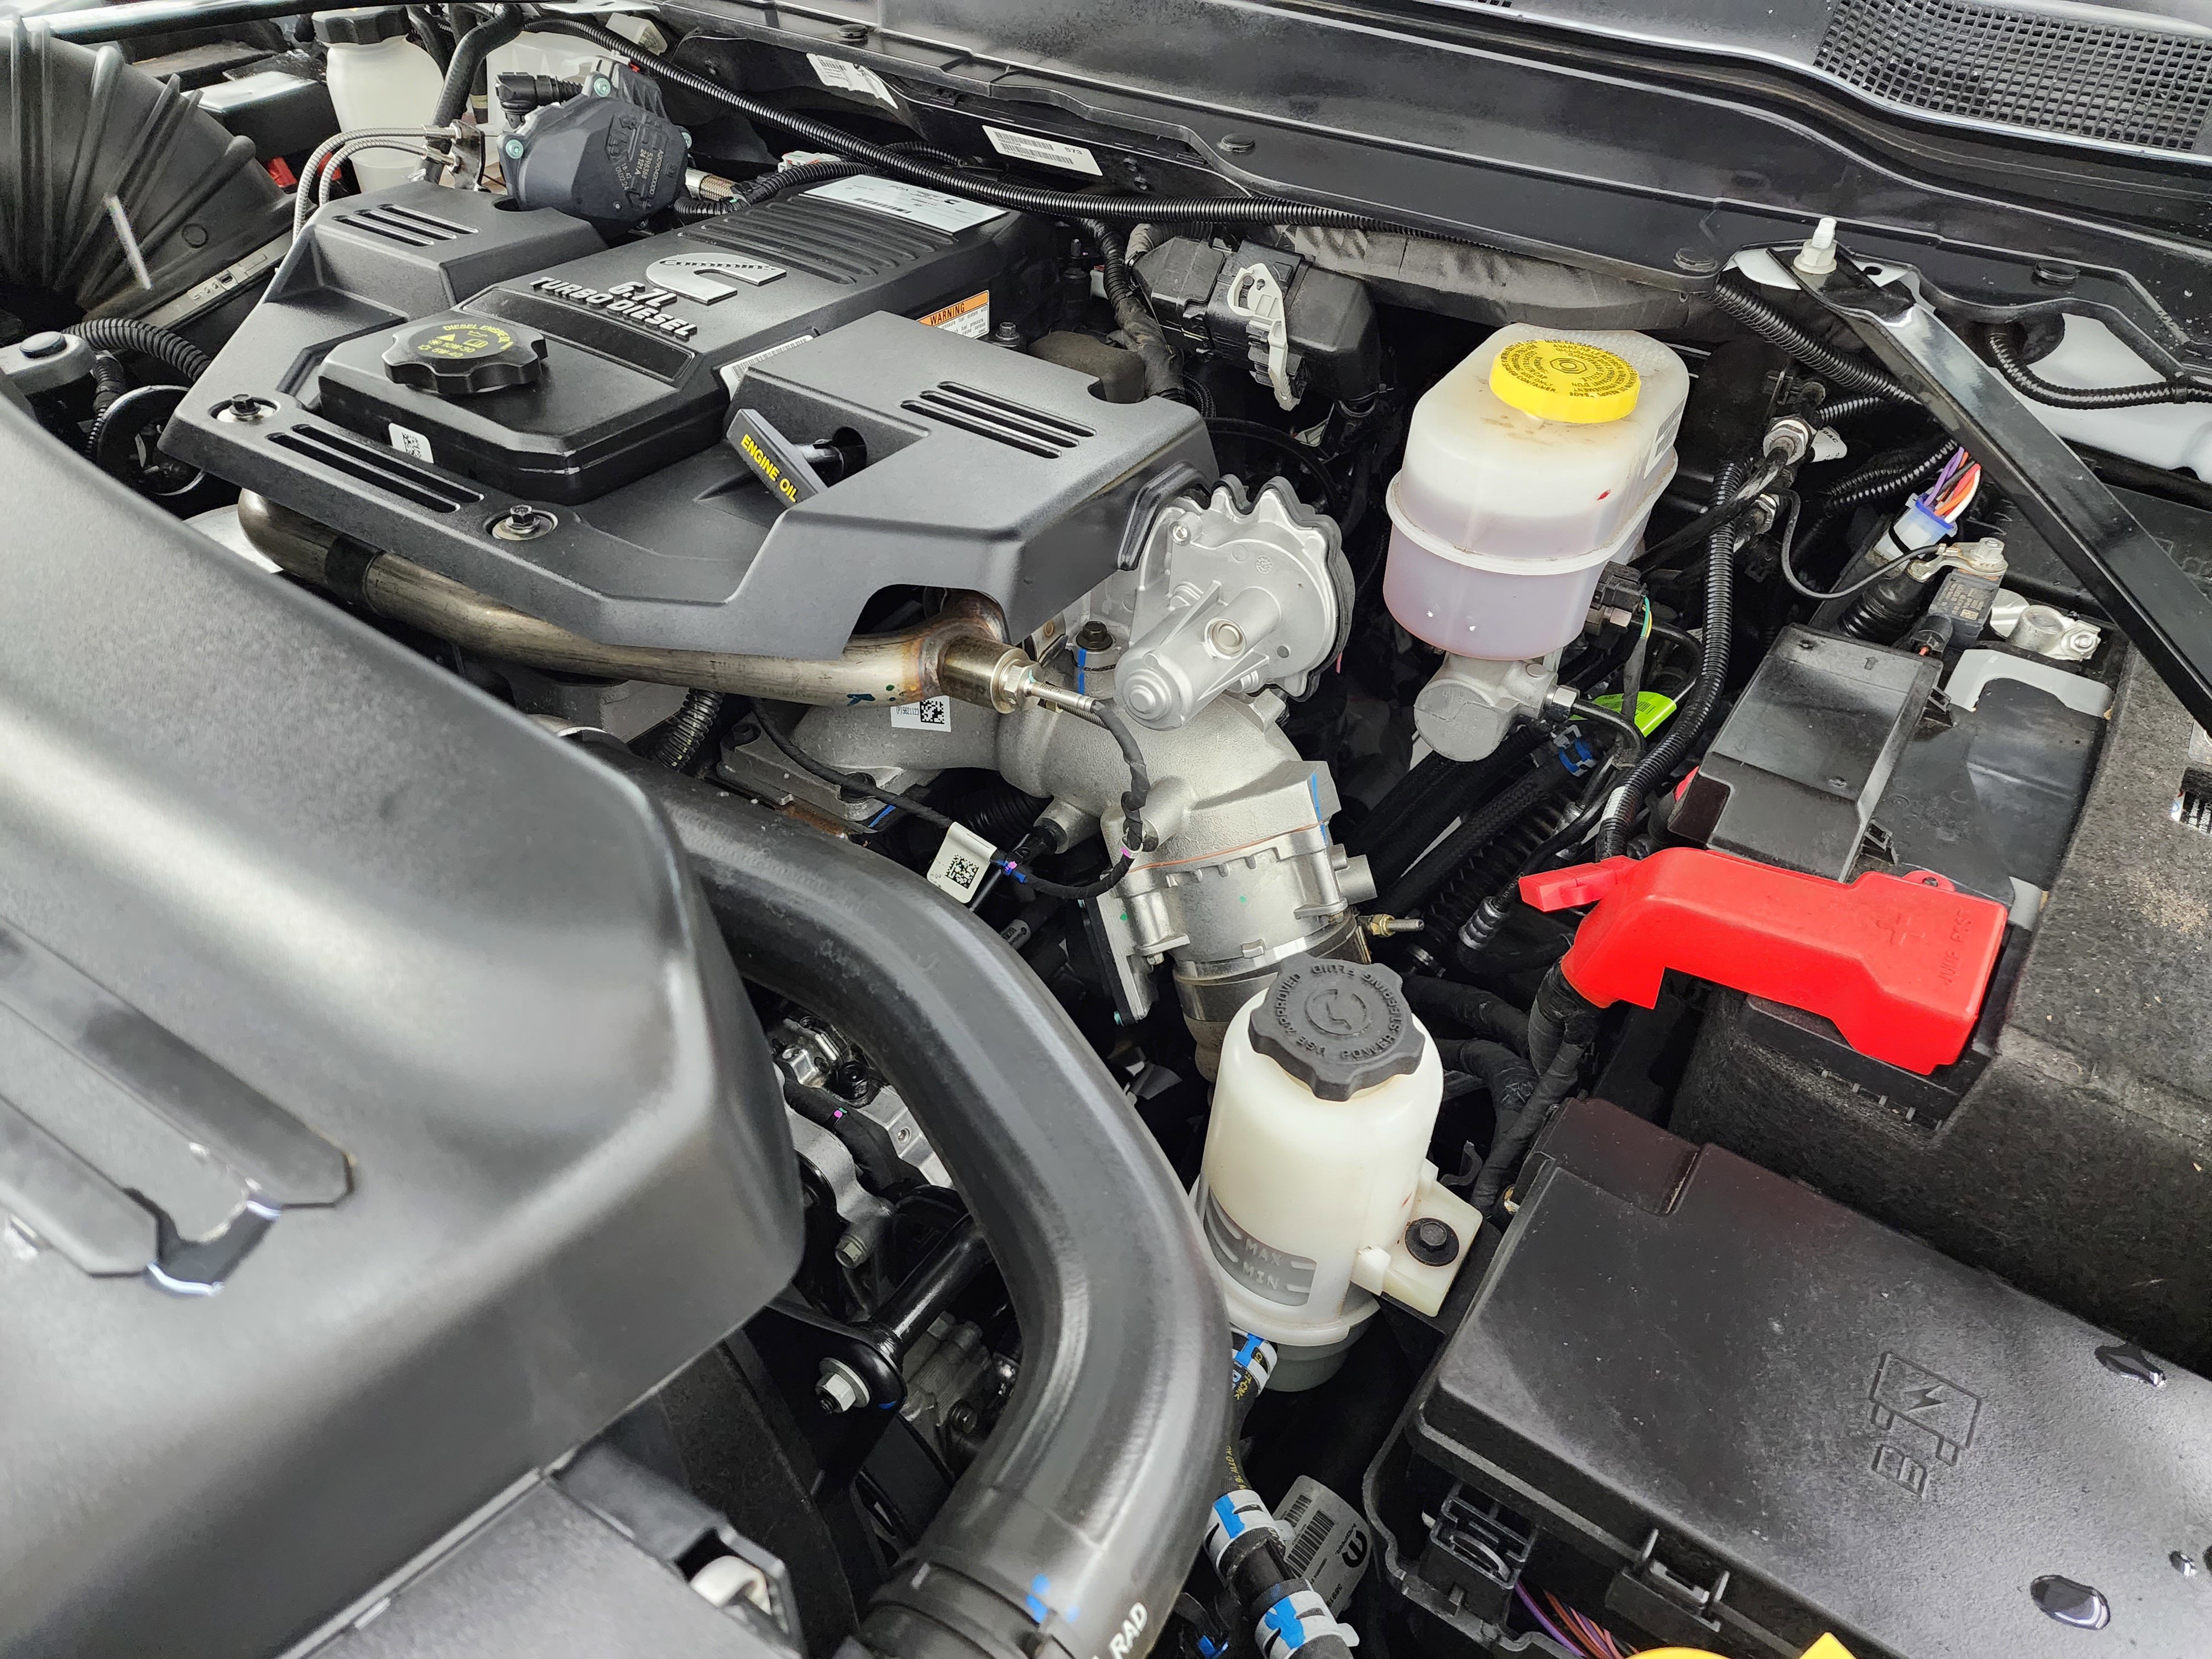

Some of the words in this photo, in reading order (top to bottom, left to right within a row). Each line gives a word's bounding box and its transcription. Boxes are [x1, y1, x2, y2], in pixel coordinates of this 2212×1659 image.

[660, 259, 778, 271] Cummins
[608, 281, 678, 308] 6.7L
[529, 276, 614, 307] TURBO
[607, 299, 698, 341] DIESEL
[930, 302, 965, 326] WARNING
[431, 348, 463, 357] 5W-40
[442, 342, 475, 353] 10W-30
[1534, 378, 1553, 387] ONLY
[740, 434, 780, 482] ENGINE
[779, 478, 797, 503] OIL
[1949, 908, 1972, 943] POST
[1310, 964, 1355, 976] FLUID
[1275, 973, 1302, 1035] APPROVED
[1361, 973, 1402, 1033] STEERING
[1339, 1034, 1397, 1059] POWER
[1245, 1238, 1282, 1266] MAX
[1243, 1261, 1280, 1290] MIN
[1108, 1601, 1147, 1659] RAD
